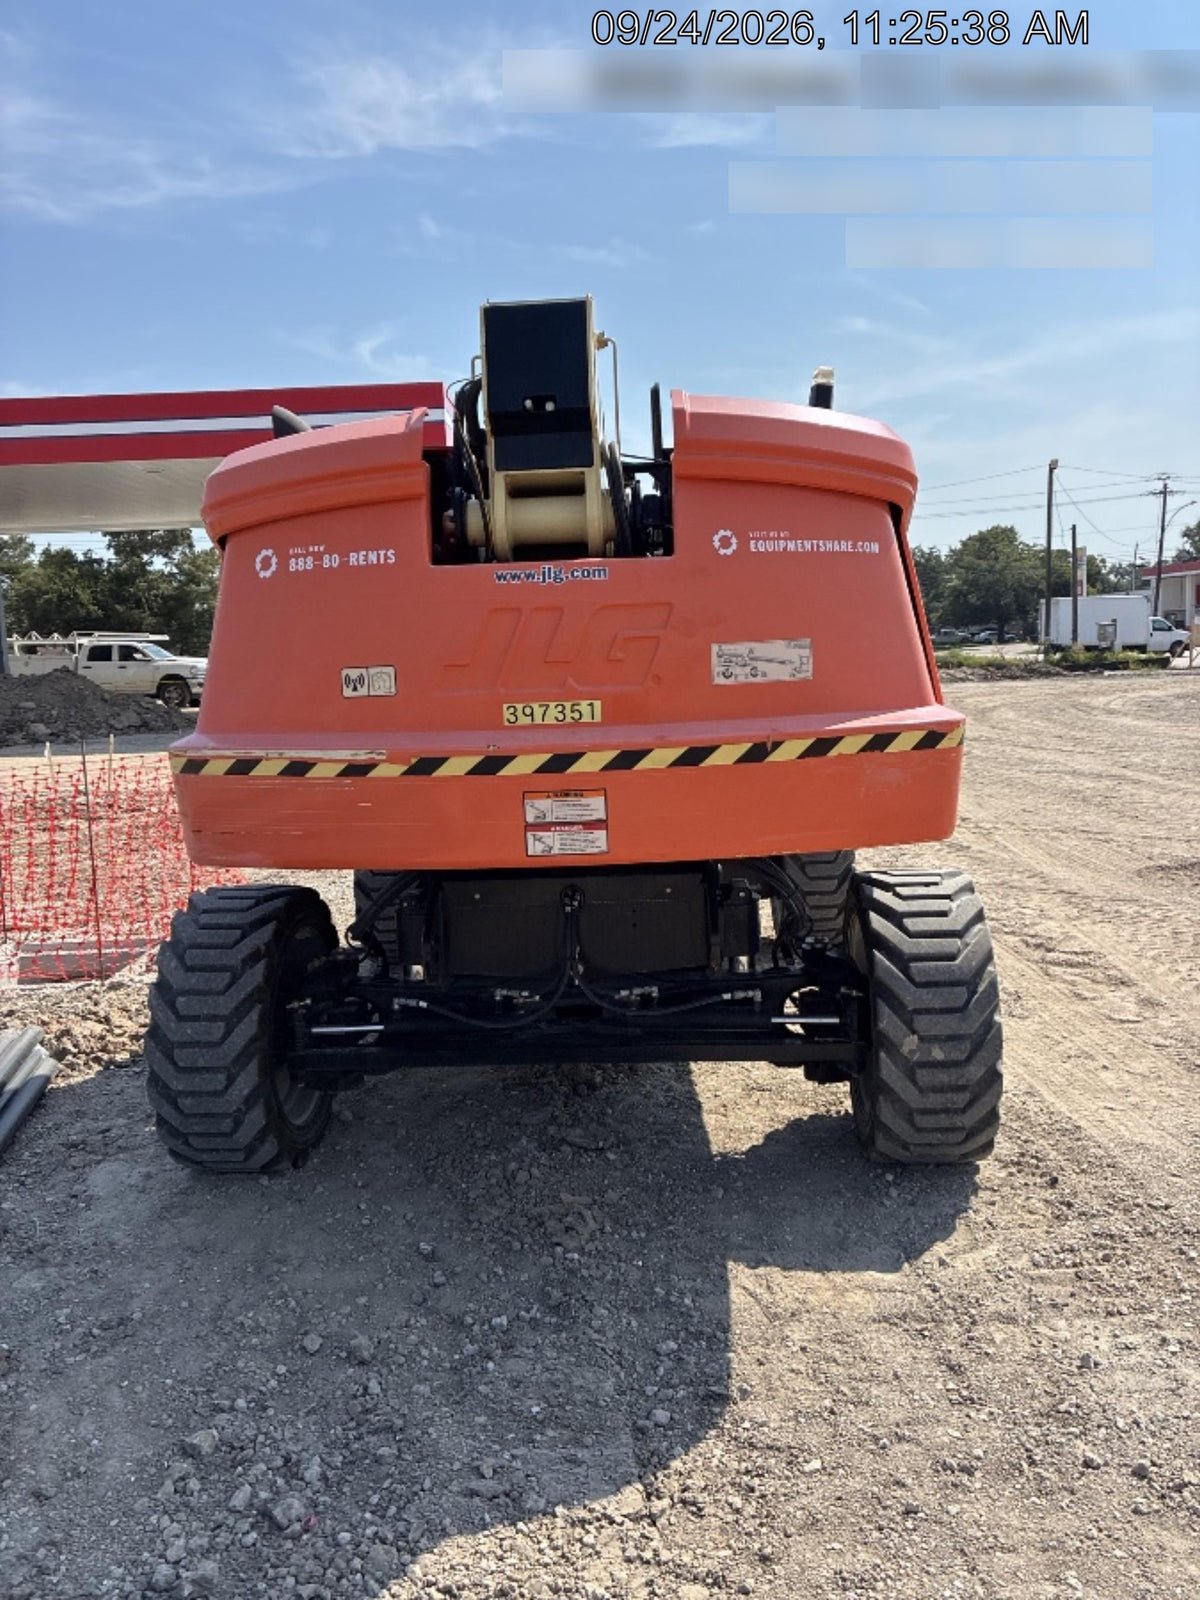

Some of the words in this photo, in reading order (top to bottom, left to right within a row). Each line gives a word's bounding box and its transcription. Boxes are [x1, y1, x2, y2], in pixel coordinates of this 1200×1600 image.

[750, 540, 879, 554] EQUIPMENTSHARE.COM
[494, 565, 608, 584] www.jlg.com
[434, 602, 674, 694] JLG
[504, 701, 597, 724] 397351
